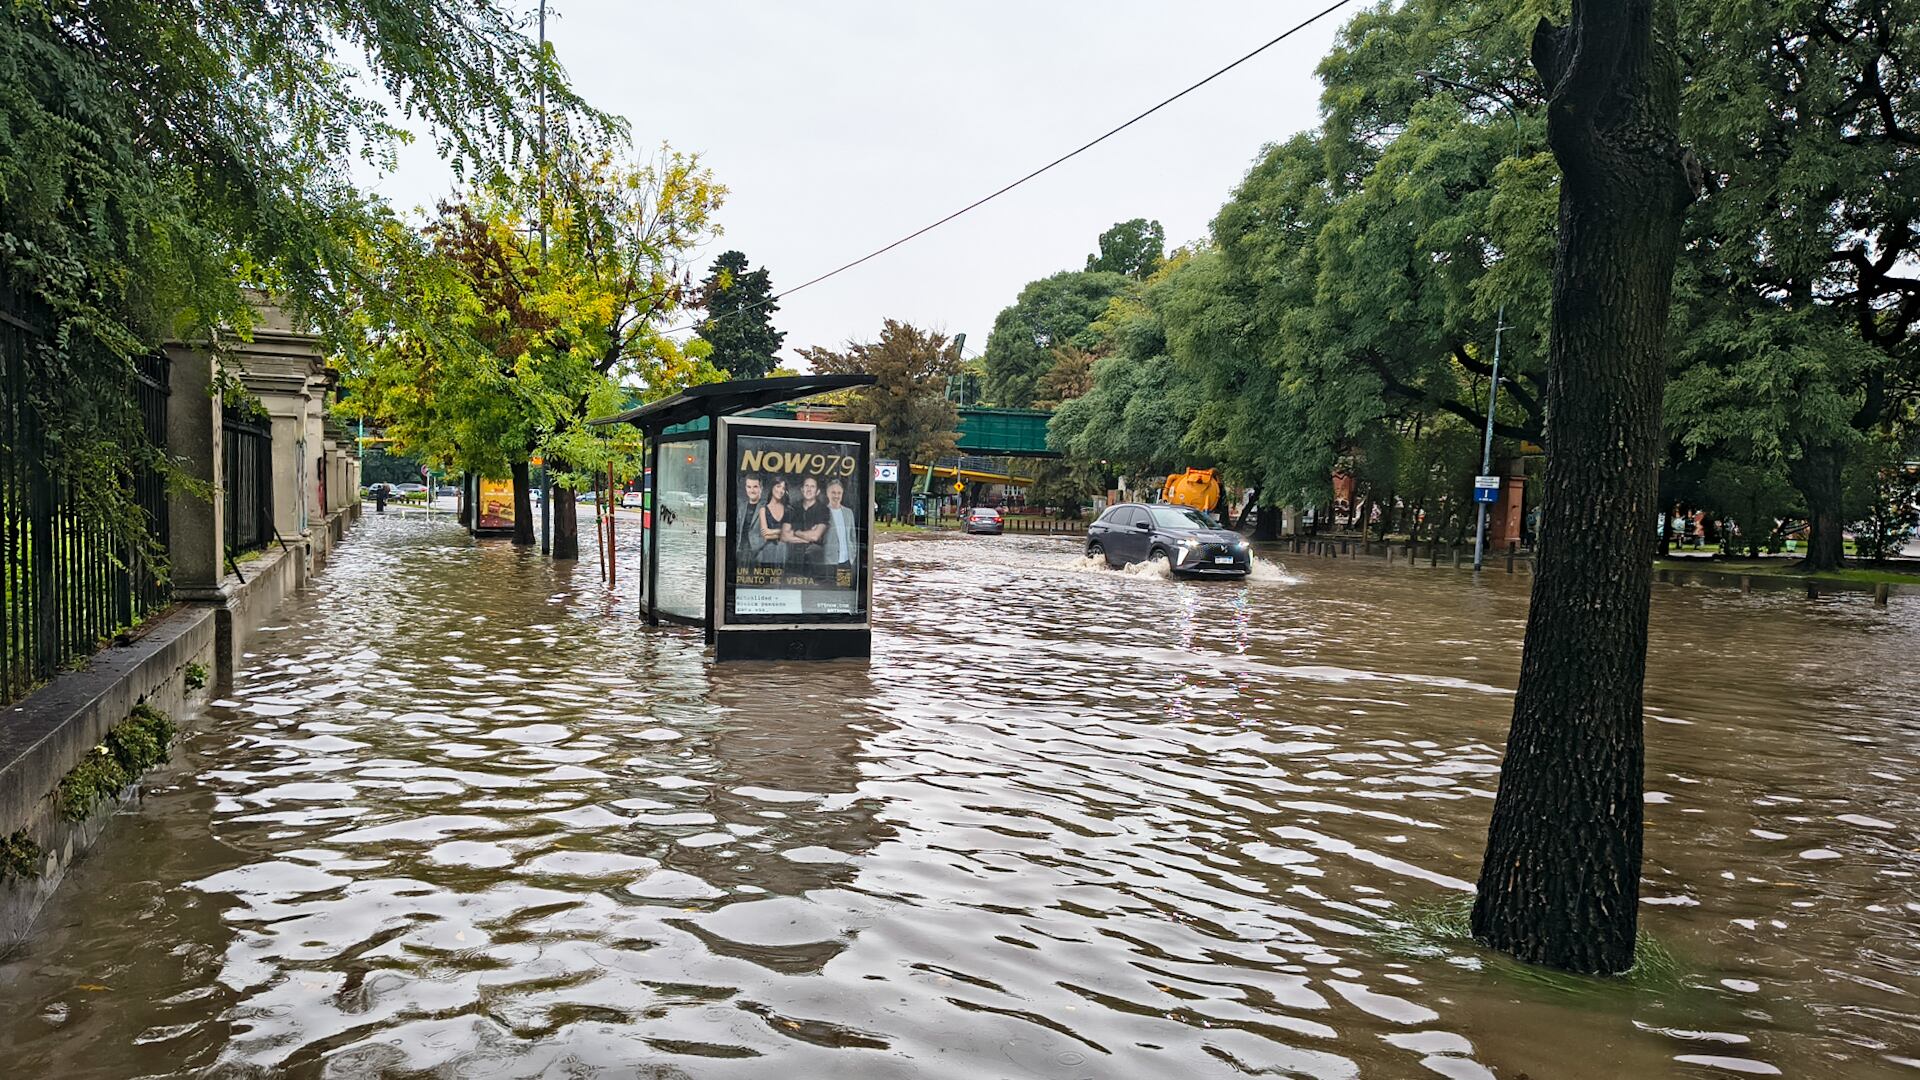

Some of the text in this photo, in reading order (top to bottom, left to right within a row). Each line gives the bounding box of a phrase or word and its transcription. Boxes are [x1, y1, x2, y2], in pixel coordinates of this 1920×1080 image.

[740, 449, 856, 476] NOW 97.9
[736, 567, 783, 576] UN NUEVO
[736, 576, 765, 585] PUNTO
[769, 576, 782, 585] DE
